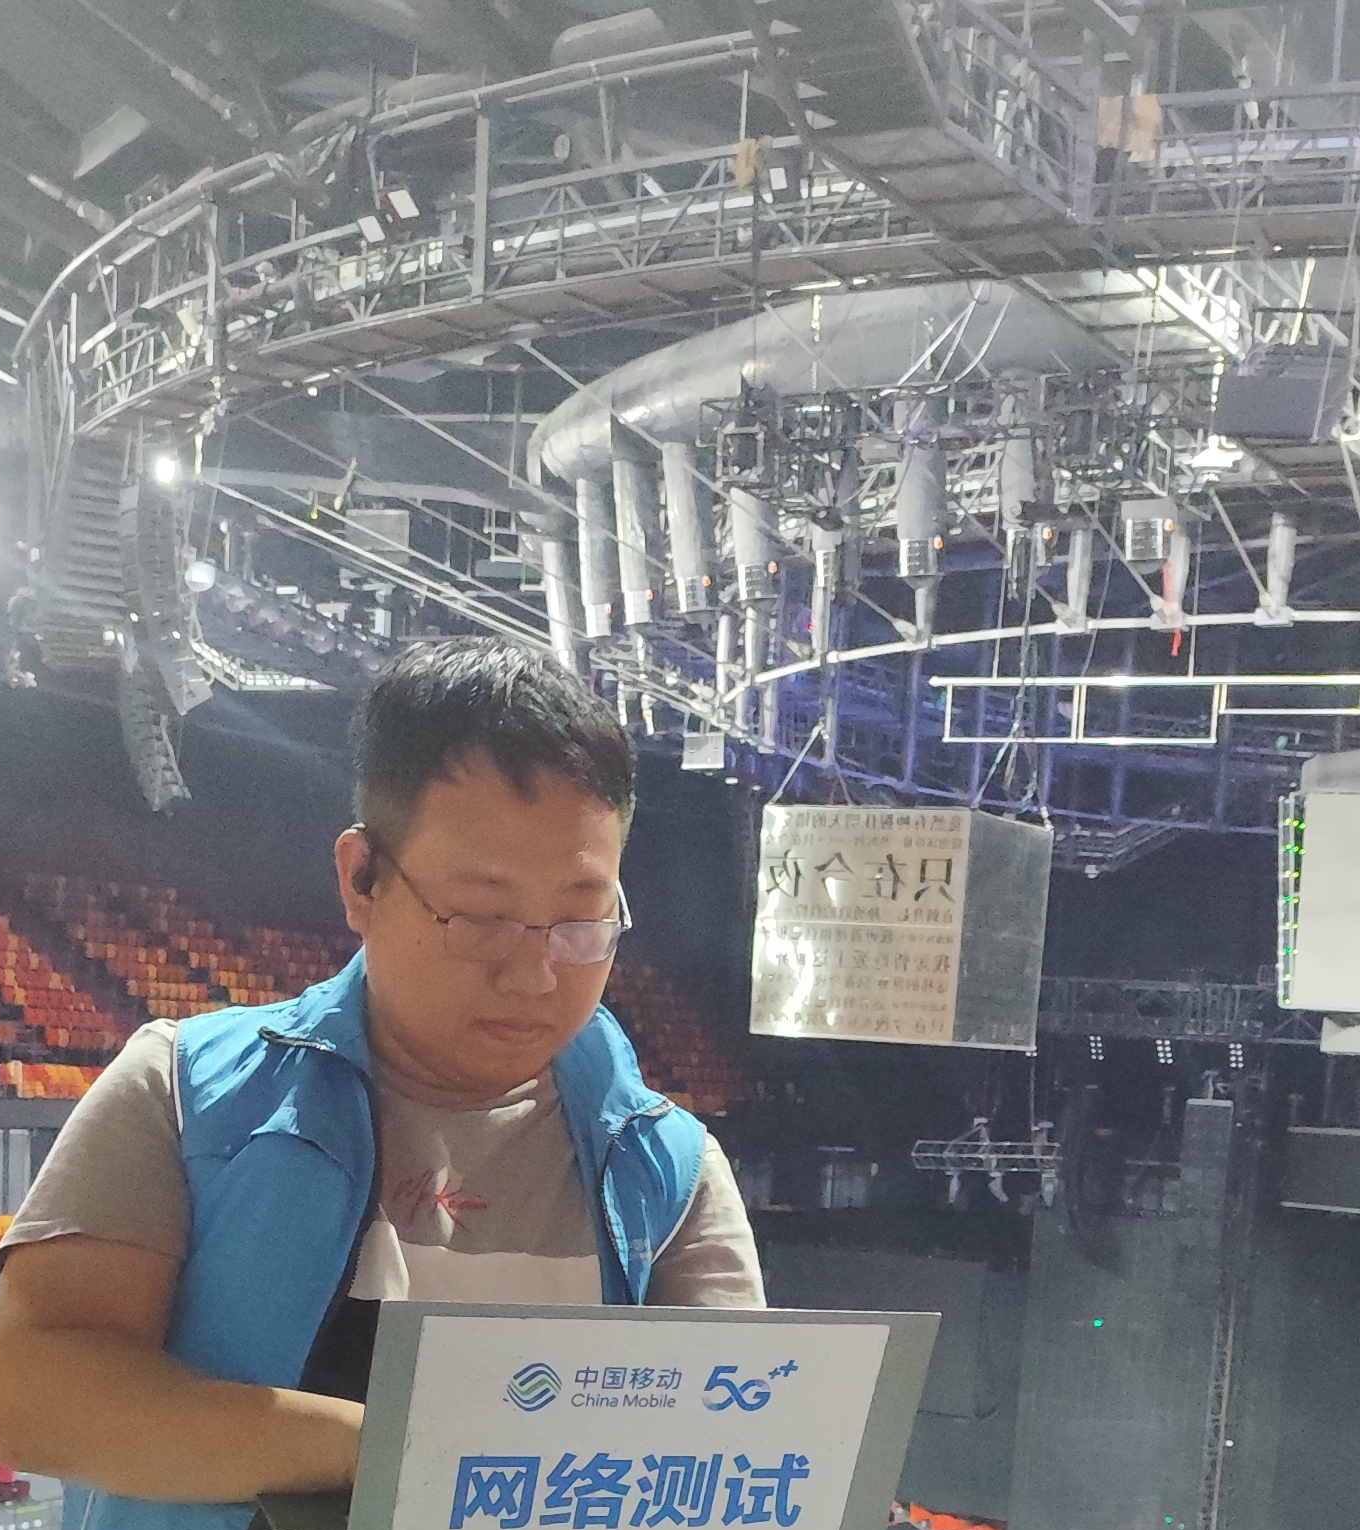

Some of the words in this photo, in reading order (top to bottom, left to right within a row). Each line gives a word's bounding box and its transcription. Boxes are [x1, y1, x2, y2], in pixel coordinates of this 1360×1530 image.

[574, 1366, 683, 1391] 中国移动
[570, 1392, 620, 1409] China
[622, 1392, 677, 1409] Mobile
[449, 1452, 810, 1530] 网络测试
